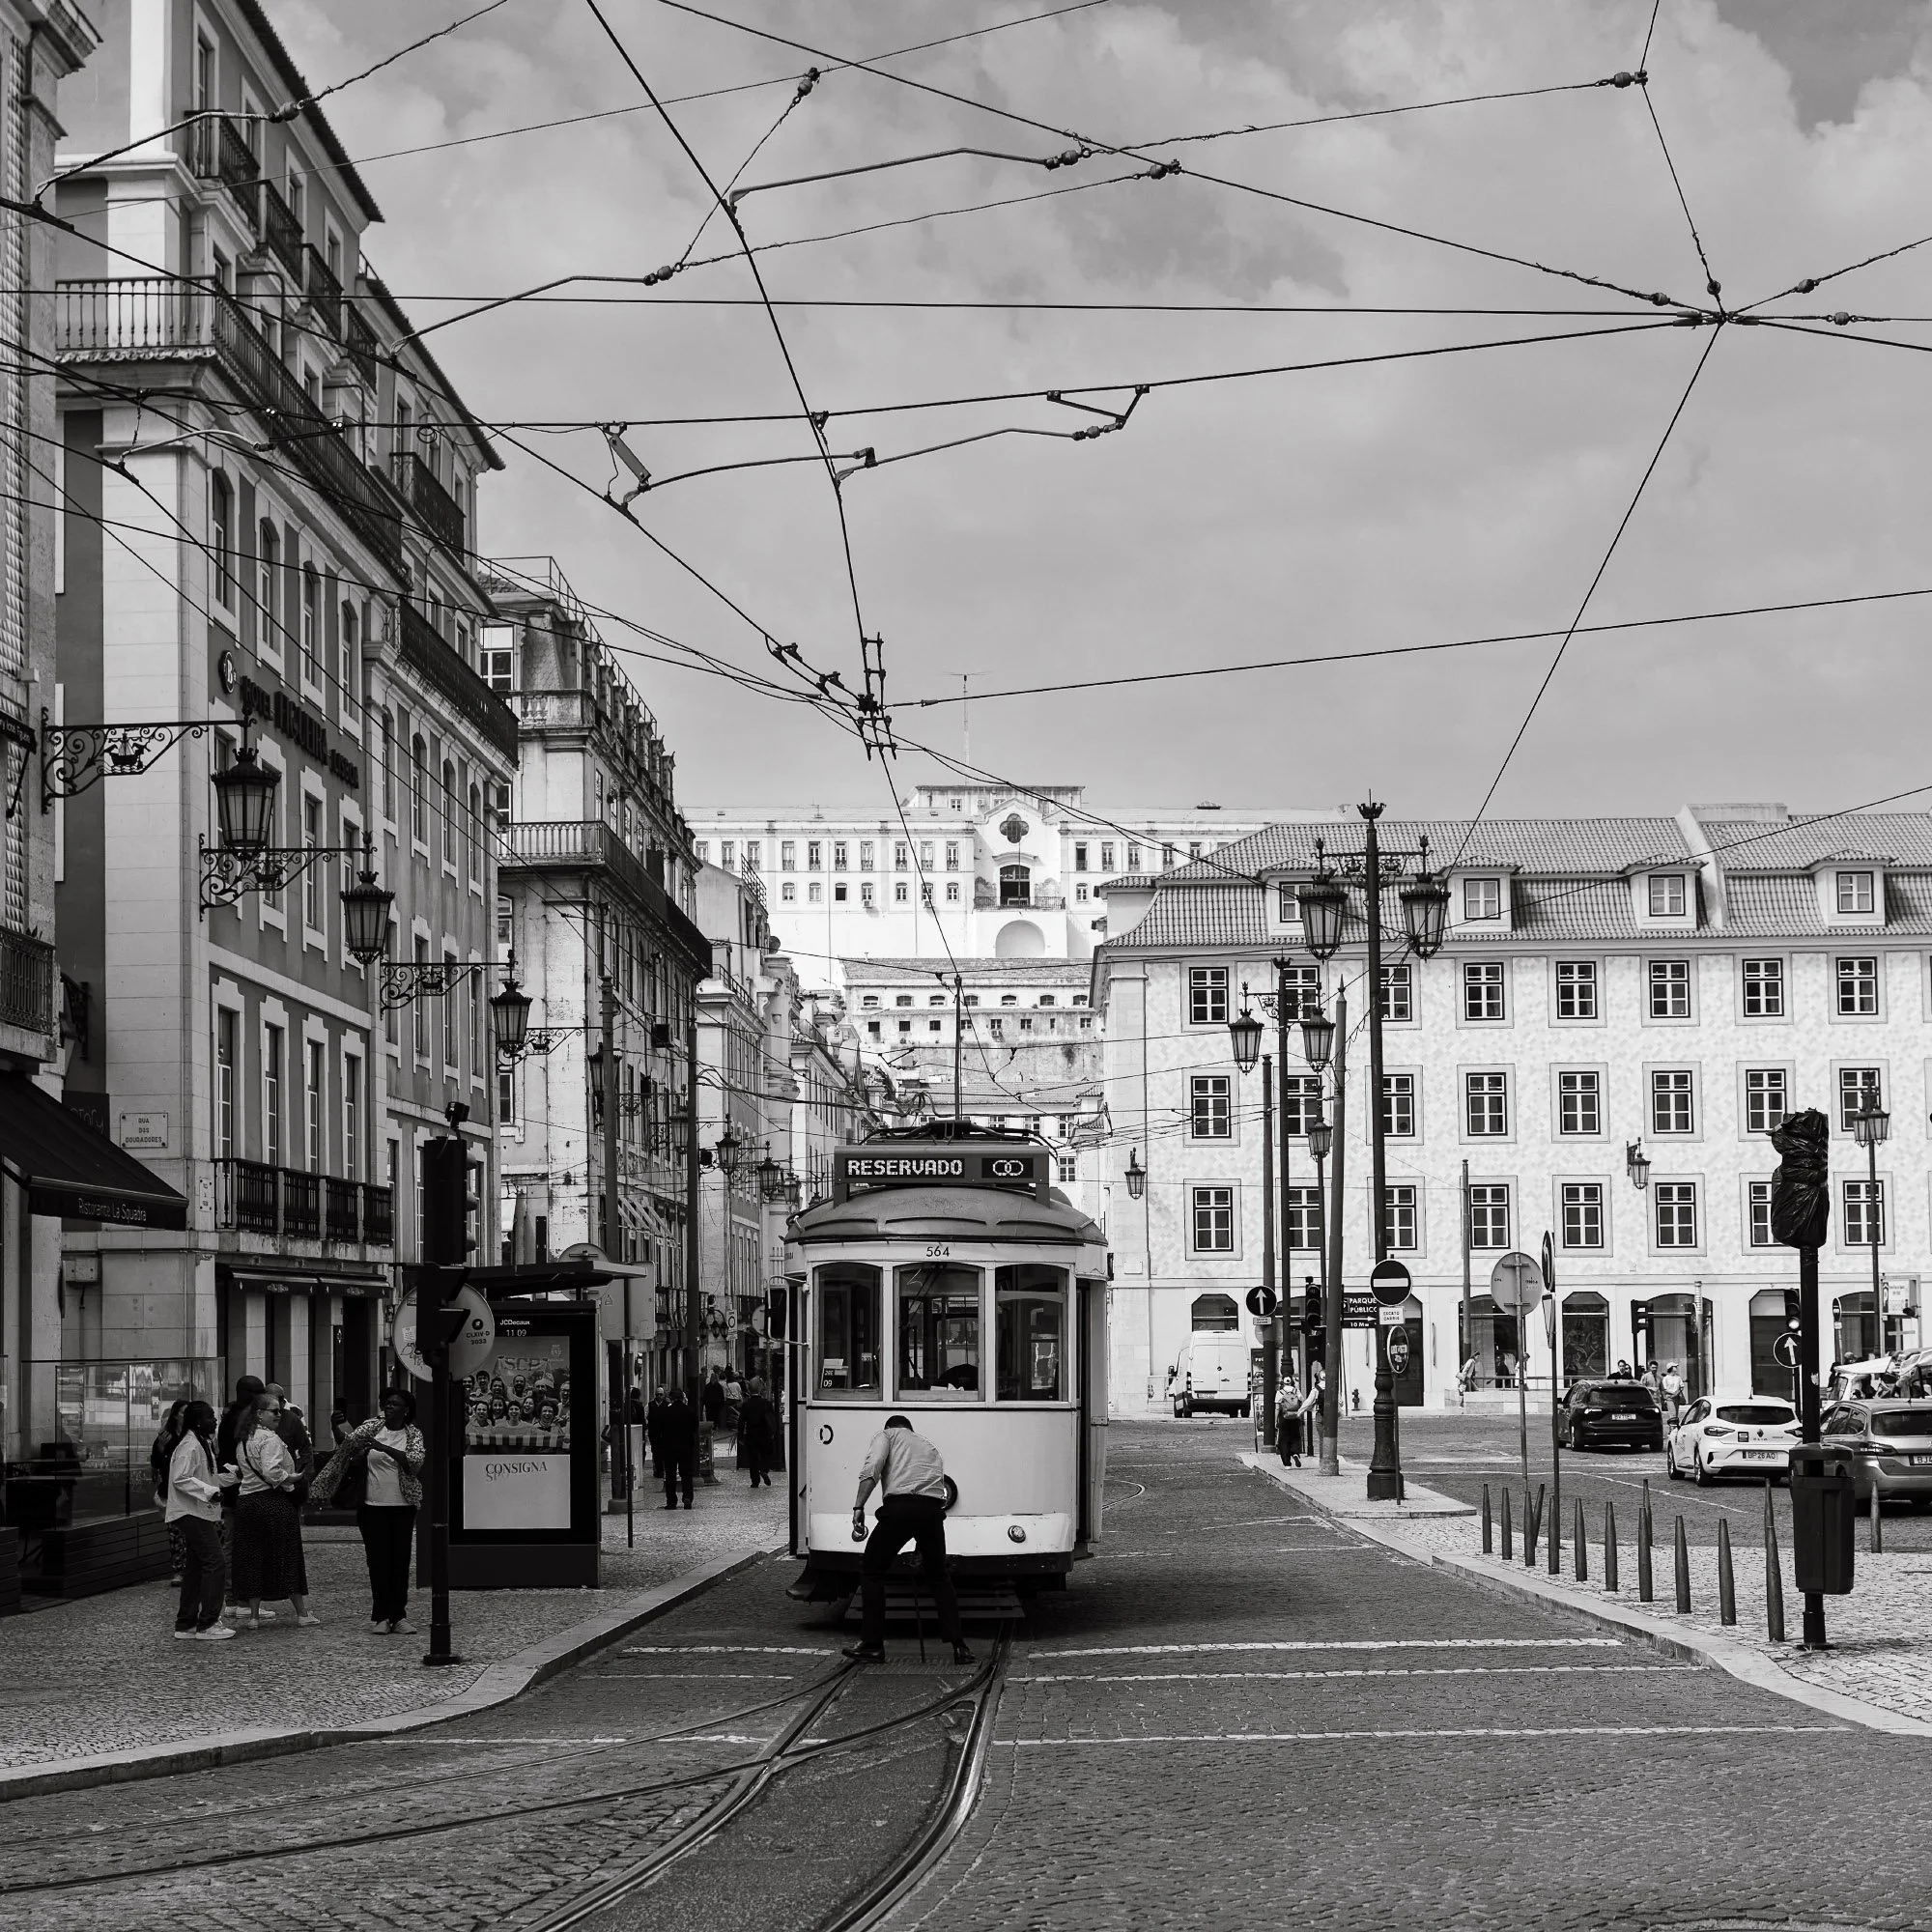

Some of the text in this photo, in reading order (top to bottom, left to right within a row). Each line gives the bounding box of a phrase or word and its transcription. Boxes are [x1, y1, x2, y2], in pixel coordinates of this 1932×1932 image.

[847, 1159, 963, 1176] RESERVADO
[77, 1198, 147, 1224] Ristorante La Squadra
[925, 1245, 950, 1258] 564
[823, 1379, 833, 1388] 09
[485, 1461, 548, 1474] CONSIGNA
